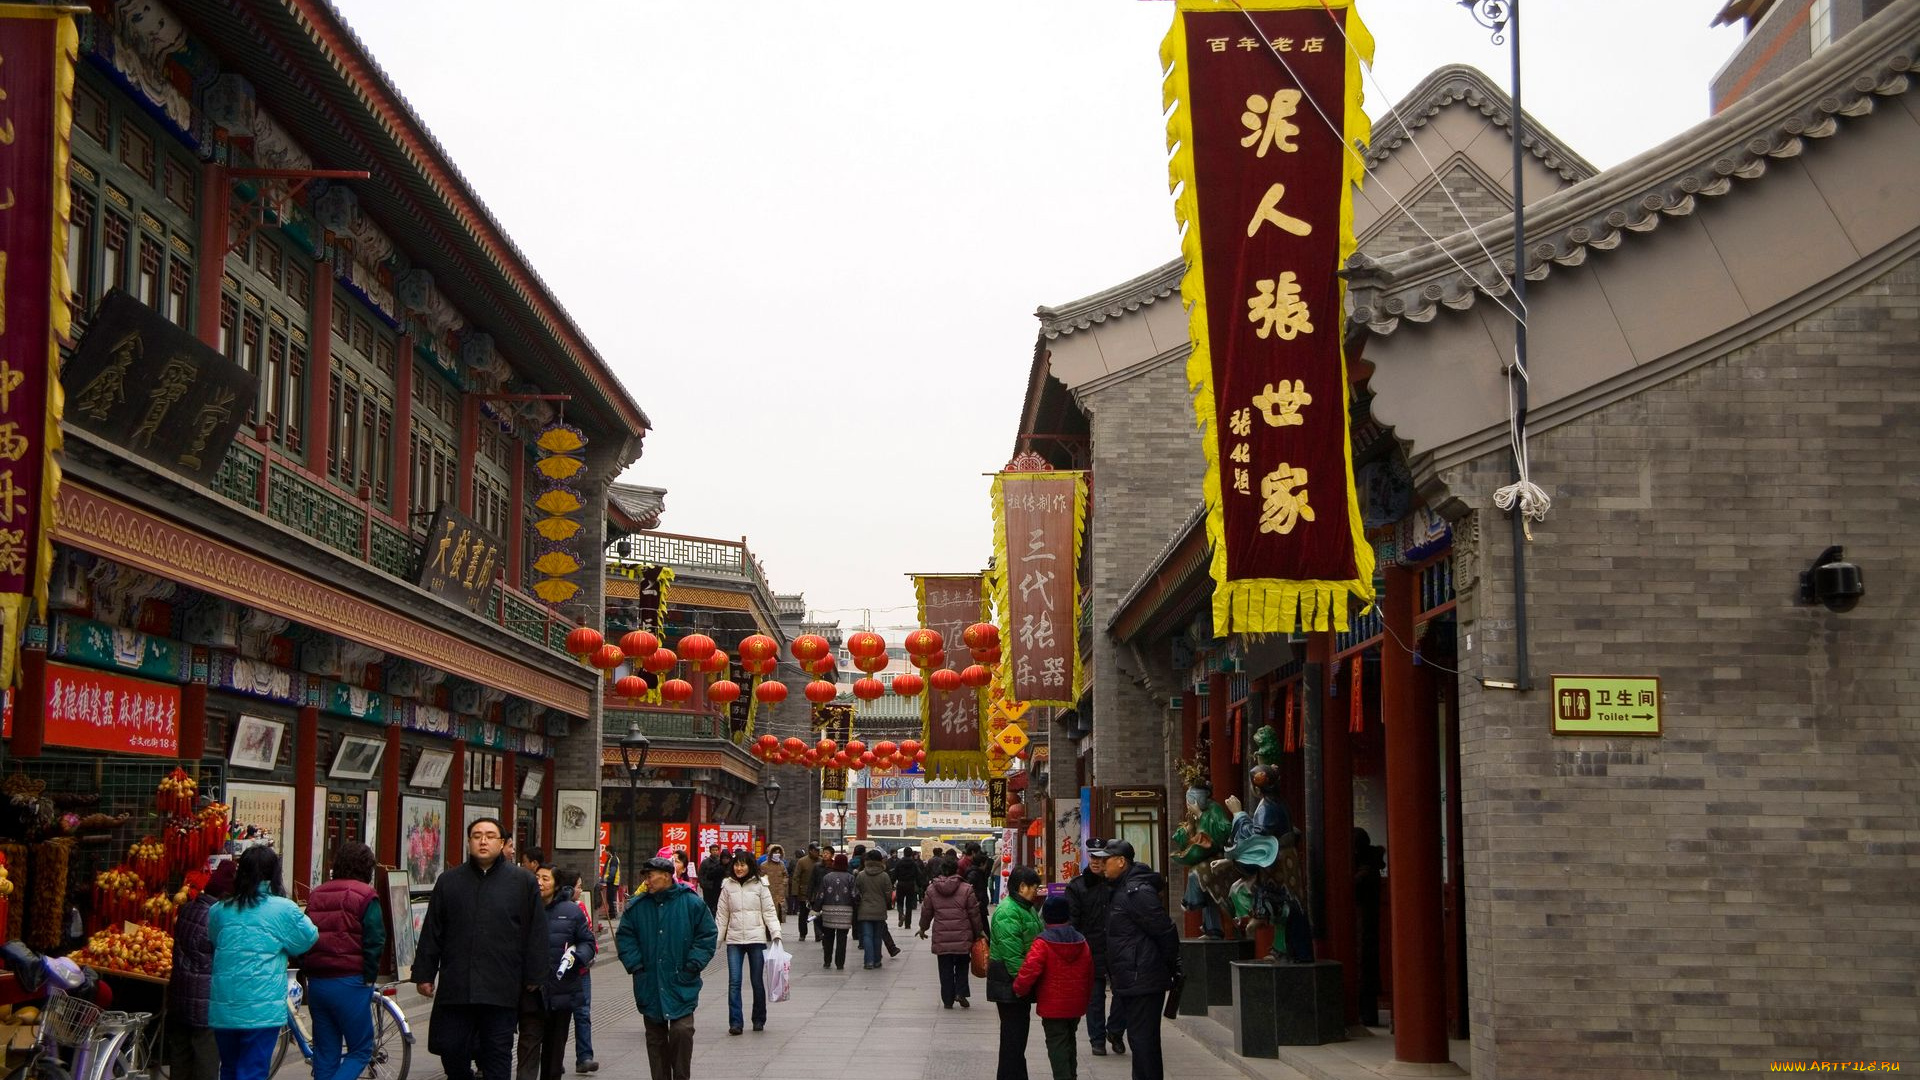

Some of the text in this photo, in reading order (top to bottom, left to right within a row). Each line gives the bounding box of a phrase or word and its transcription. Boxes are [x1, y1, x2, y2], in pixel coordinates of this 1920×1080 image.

[1206, 35, 1325, 53] 百年老店
[1595, 689, 1655, 707] 卫生间
[1598, 712, 1629, 721] Toilet
